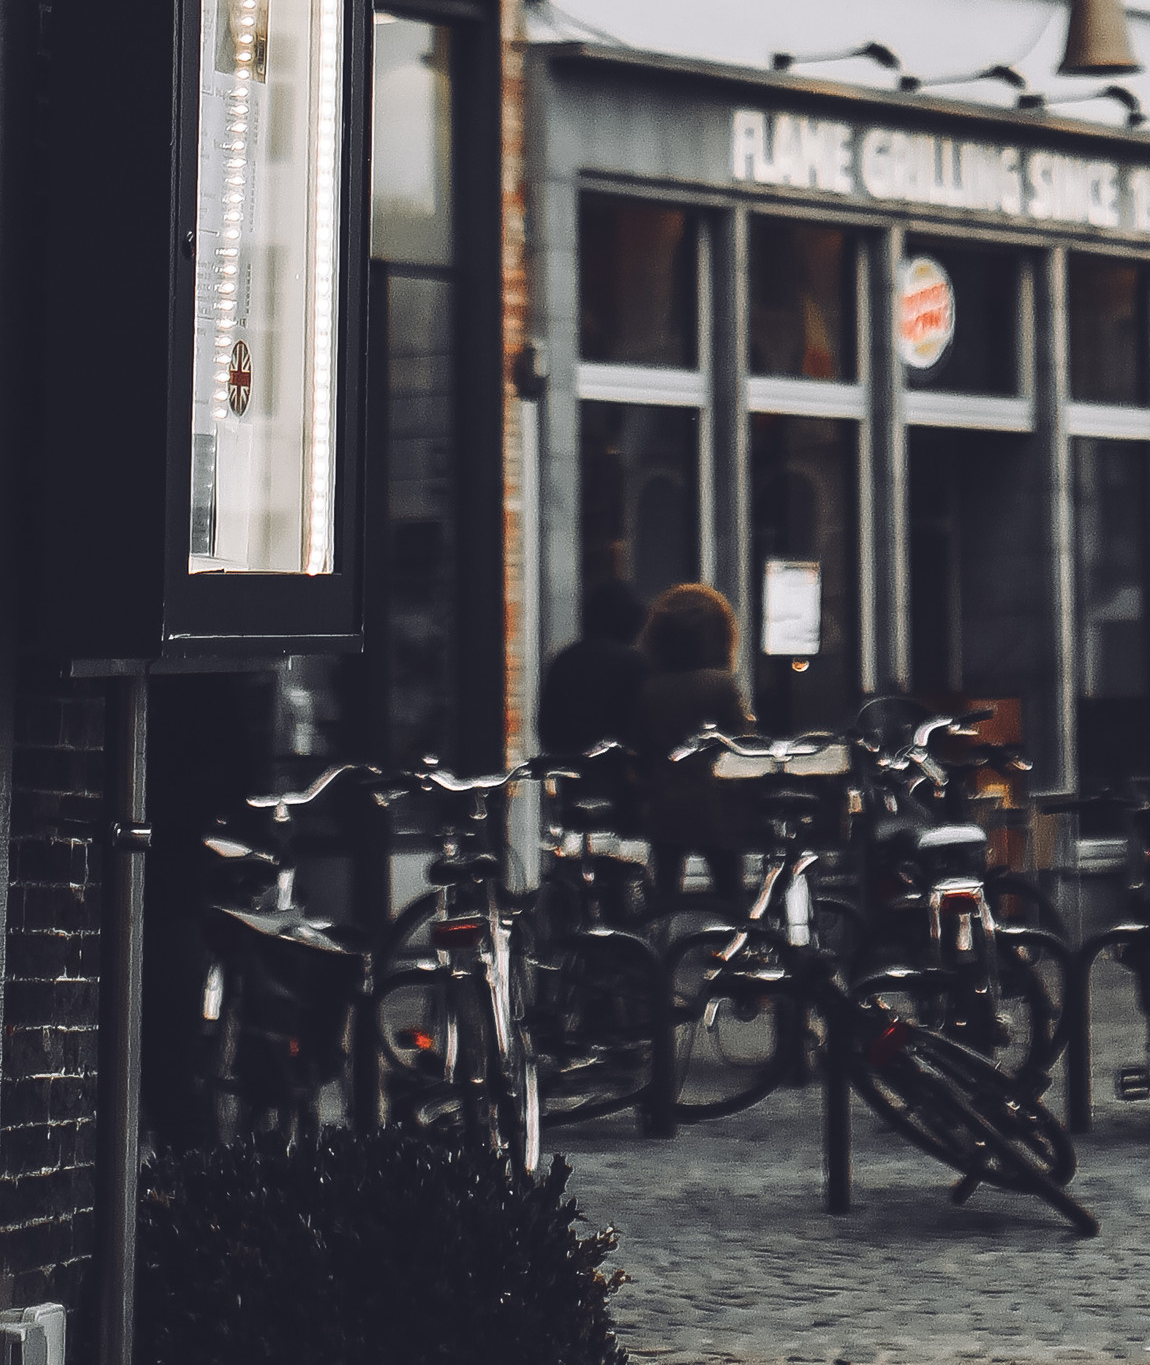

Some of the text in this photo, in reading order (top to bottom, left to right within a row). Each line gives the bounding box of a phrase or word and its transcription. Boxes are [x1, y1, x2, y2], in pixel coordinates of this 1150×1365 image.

[732, 109, 853, 195] FLAME
[860, 127, 1022, 217] GRILLING
[1027, 149, 1122, 229] SINCE
